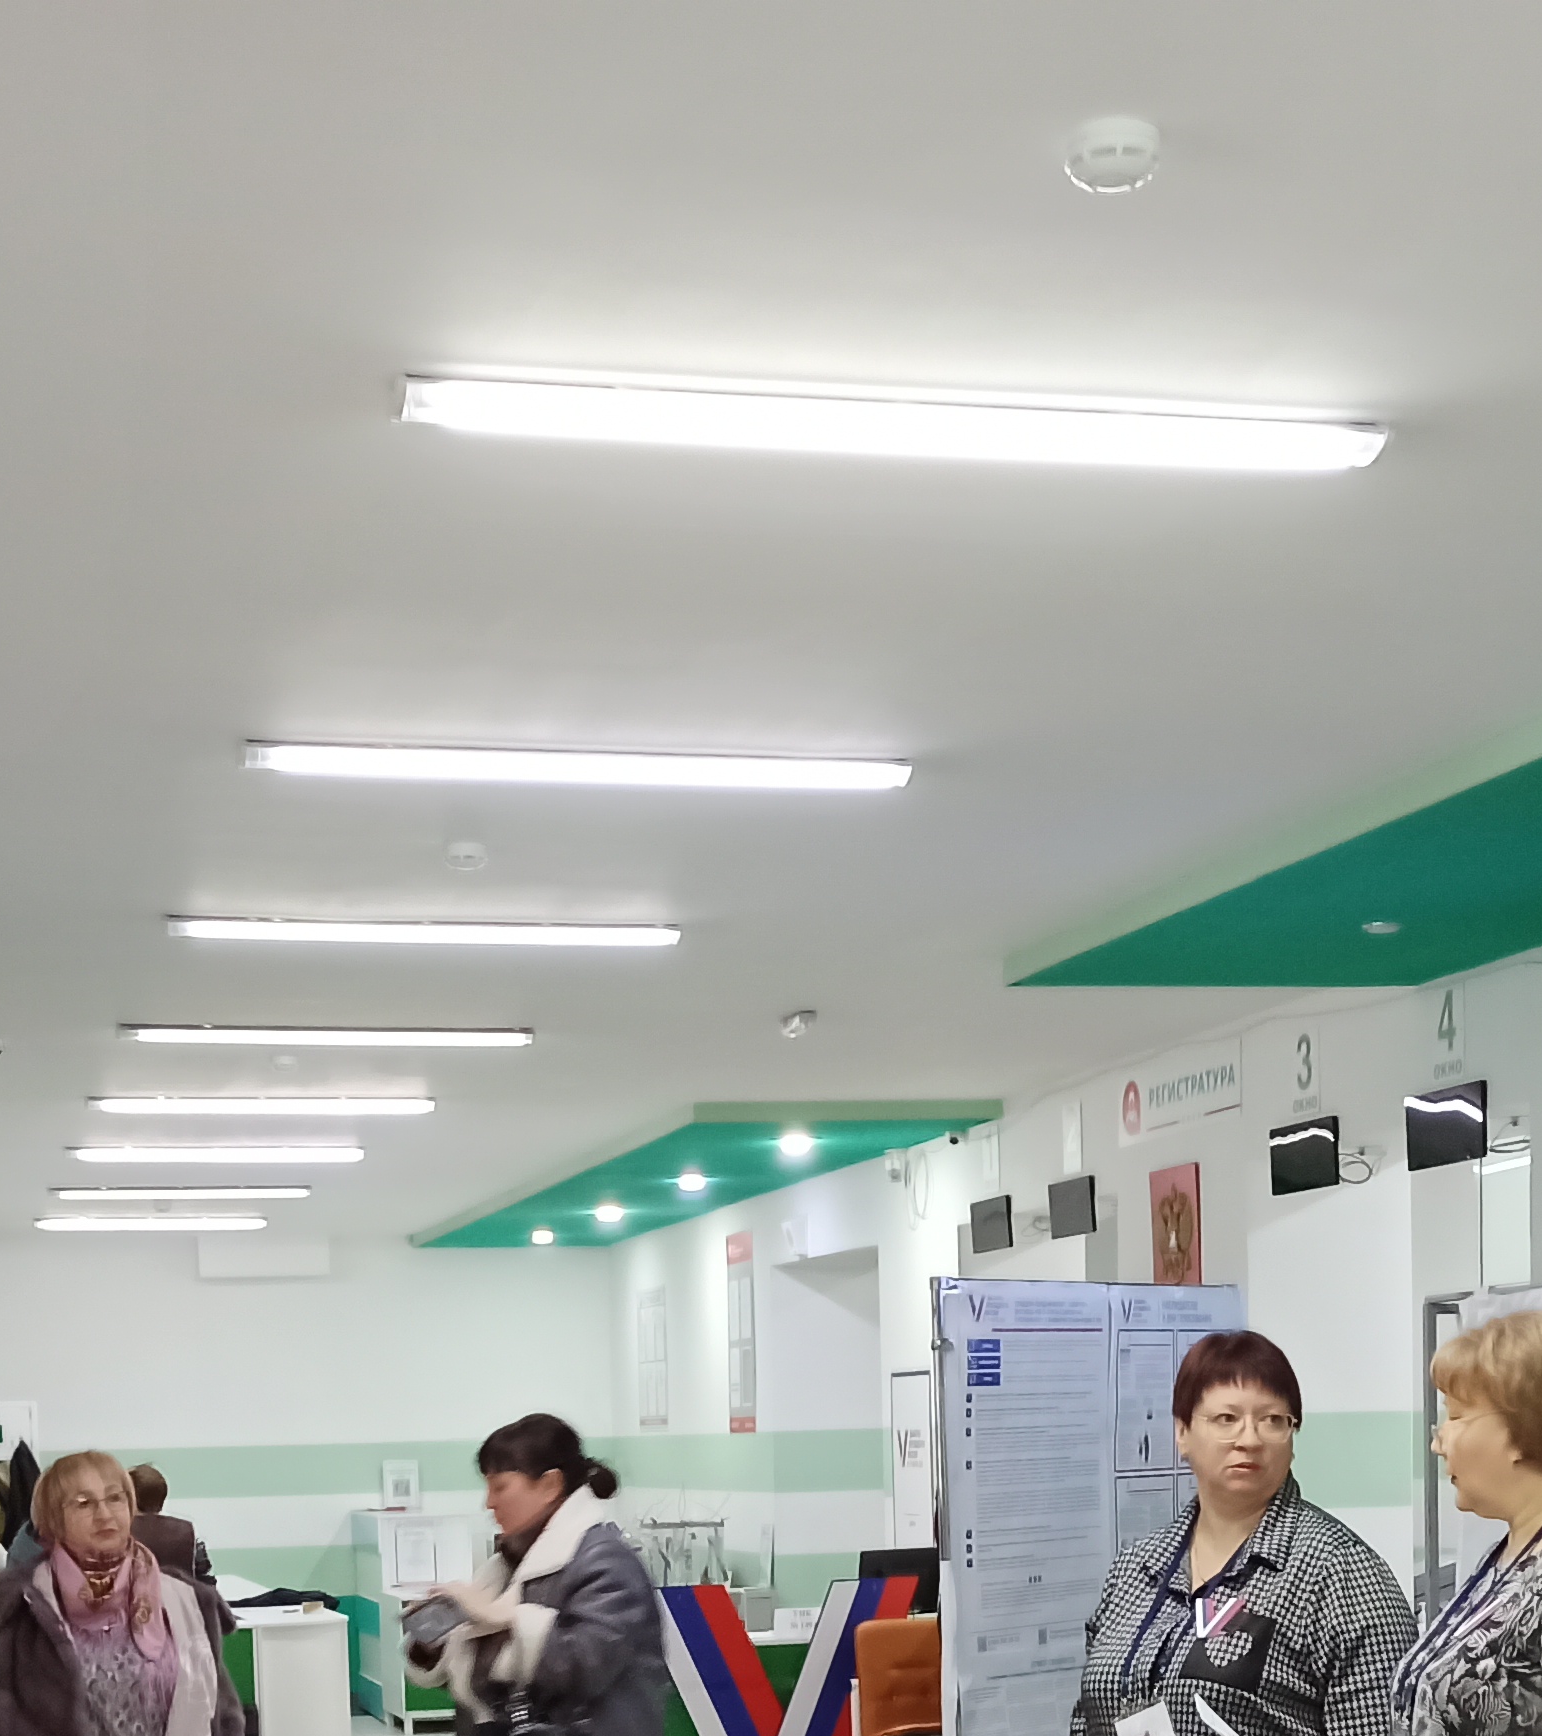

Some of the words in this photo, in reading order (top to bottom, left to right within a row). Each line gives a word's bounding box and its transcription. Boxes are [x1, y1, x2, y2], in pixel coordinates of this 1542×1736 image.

[1437, 989, 1457, 1051] 4
[1148, 1063, 1236, 1110] РЕГИСТРАТУРА
[1296, 1033, 1313, 1091] 3
